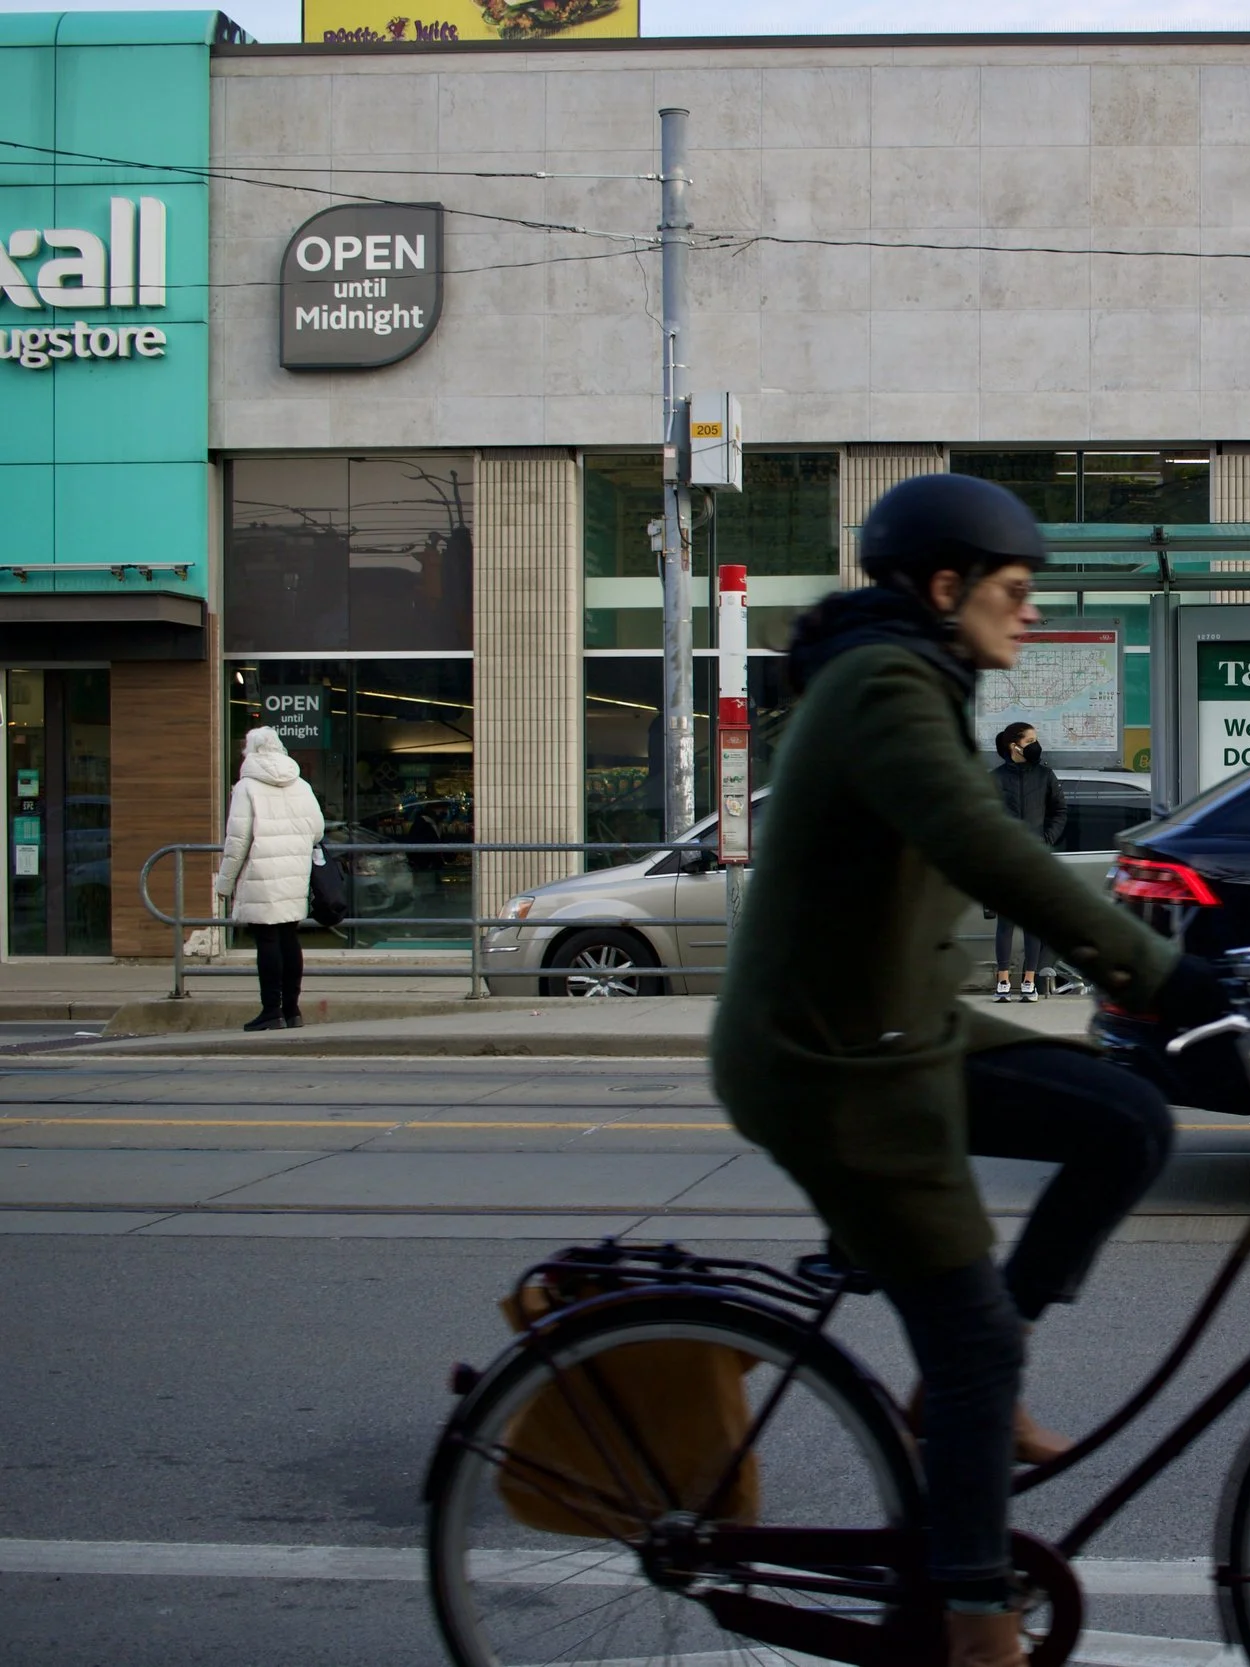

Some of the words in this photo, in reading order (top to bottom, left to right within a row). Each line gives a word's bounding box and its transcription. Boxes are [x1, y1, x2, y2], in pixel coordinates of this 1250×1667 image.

[296, 234, 425, 272] OPEN
[333, 277, 387, 299] until
[295, 303, 424, 335] Midnight
[696, 425, 719, 436] 205
[265, 695, 320, 711] OPEN
[281, 713, 304, 723] until
[271, 724, 319, 739] idnight
